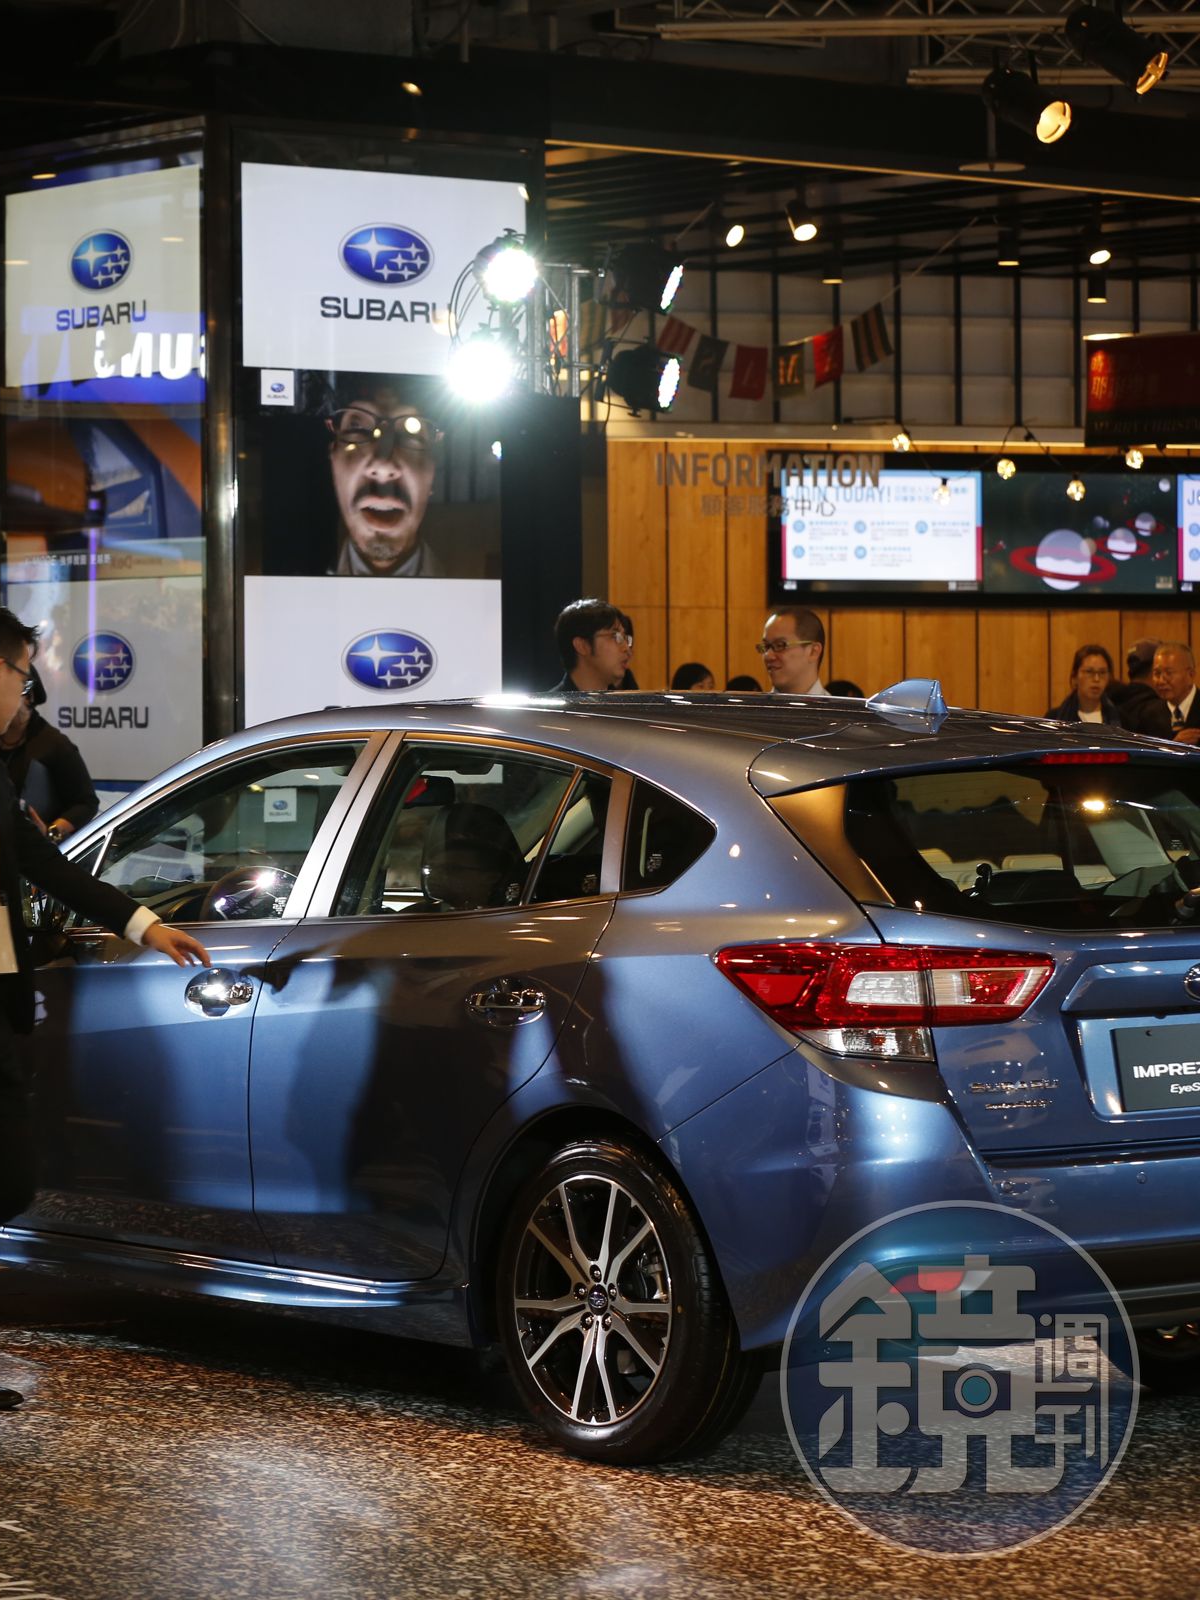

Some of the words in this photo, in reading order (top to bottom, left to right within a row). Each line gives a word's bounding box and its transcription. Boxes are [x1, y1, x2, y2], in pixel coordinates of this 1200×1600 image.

[56, 299, 147, 332] SUBARU
[320, 296, 452, 324] SUBARU
[655, 453, 883, 488] INFORMATION
[834, 485, 892, 503] TODAY!
[57, 706, 149, 729] SUBARU
